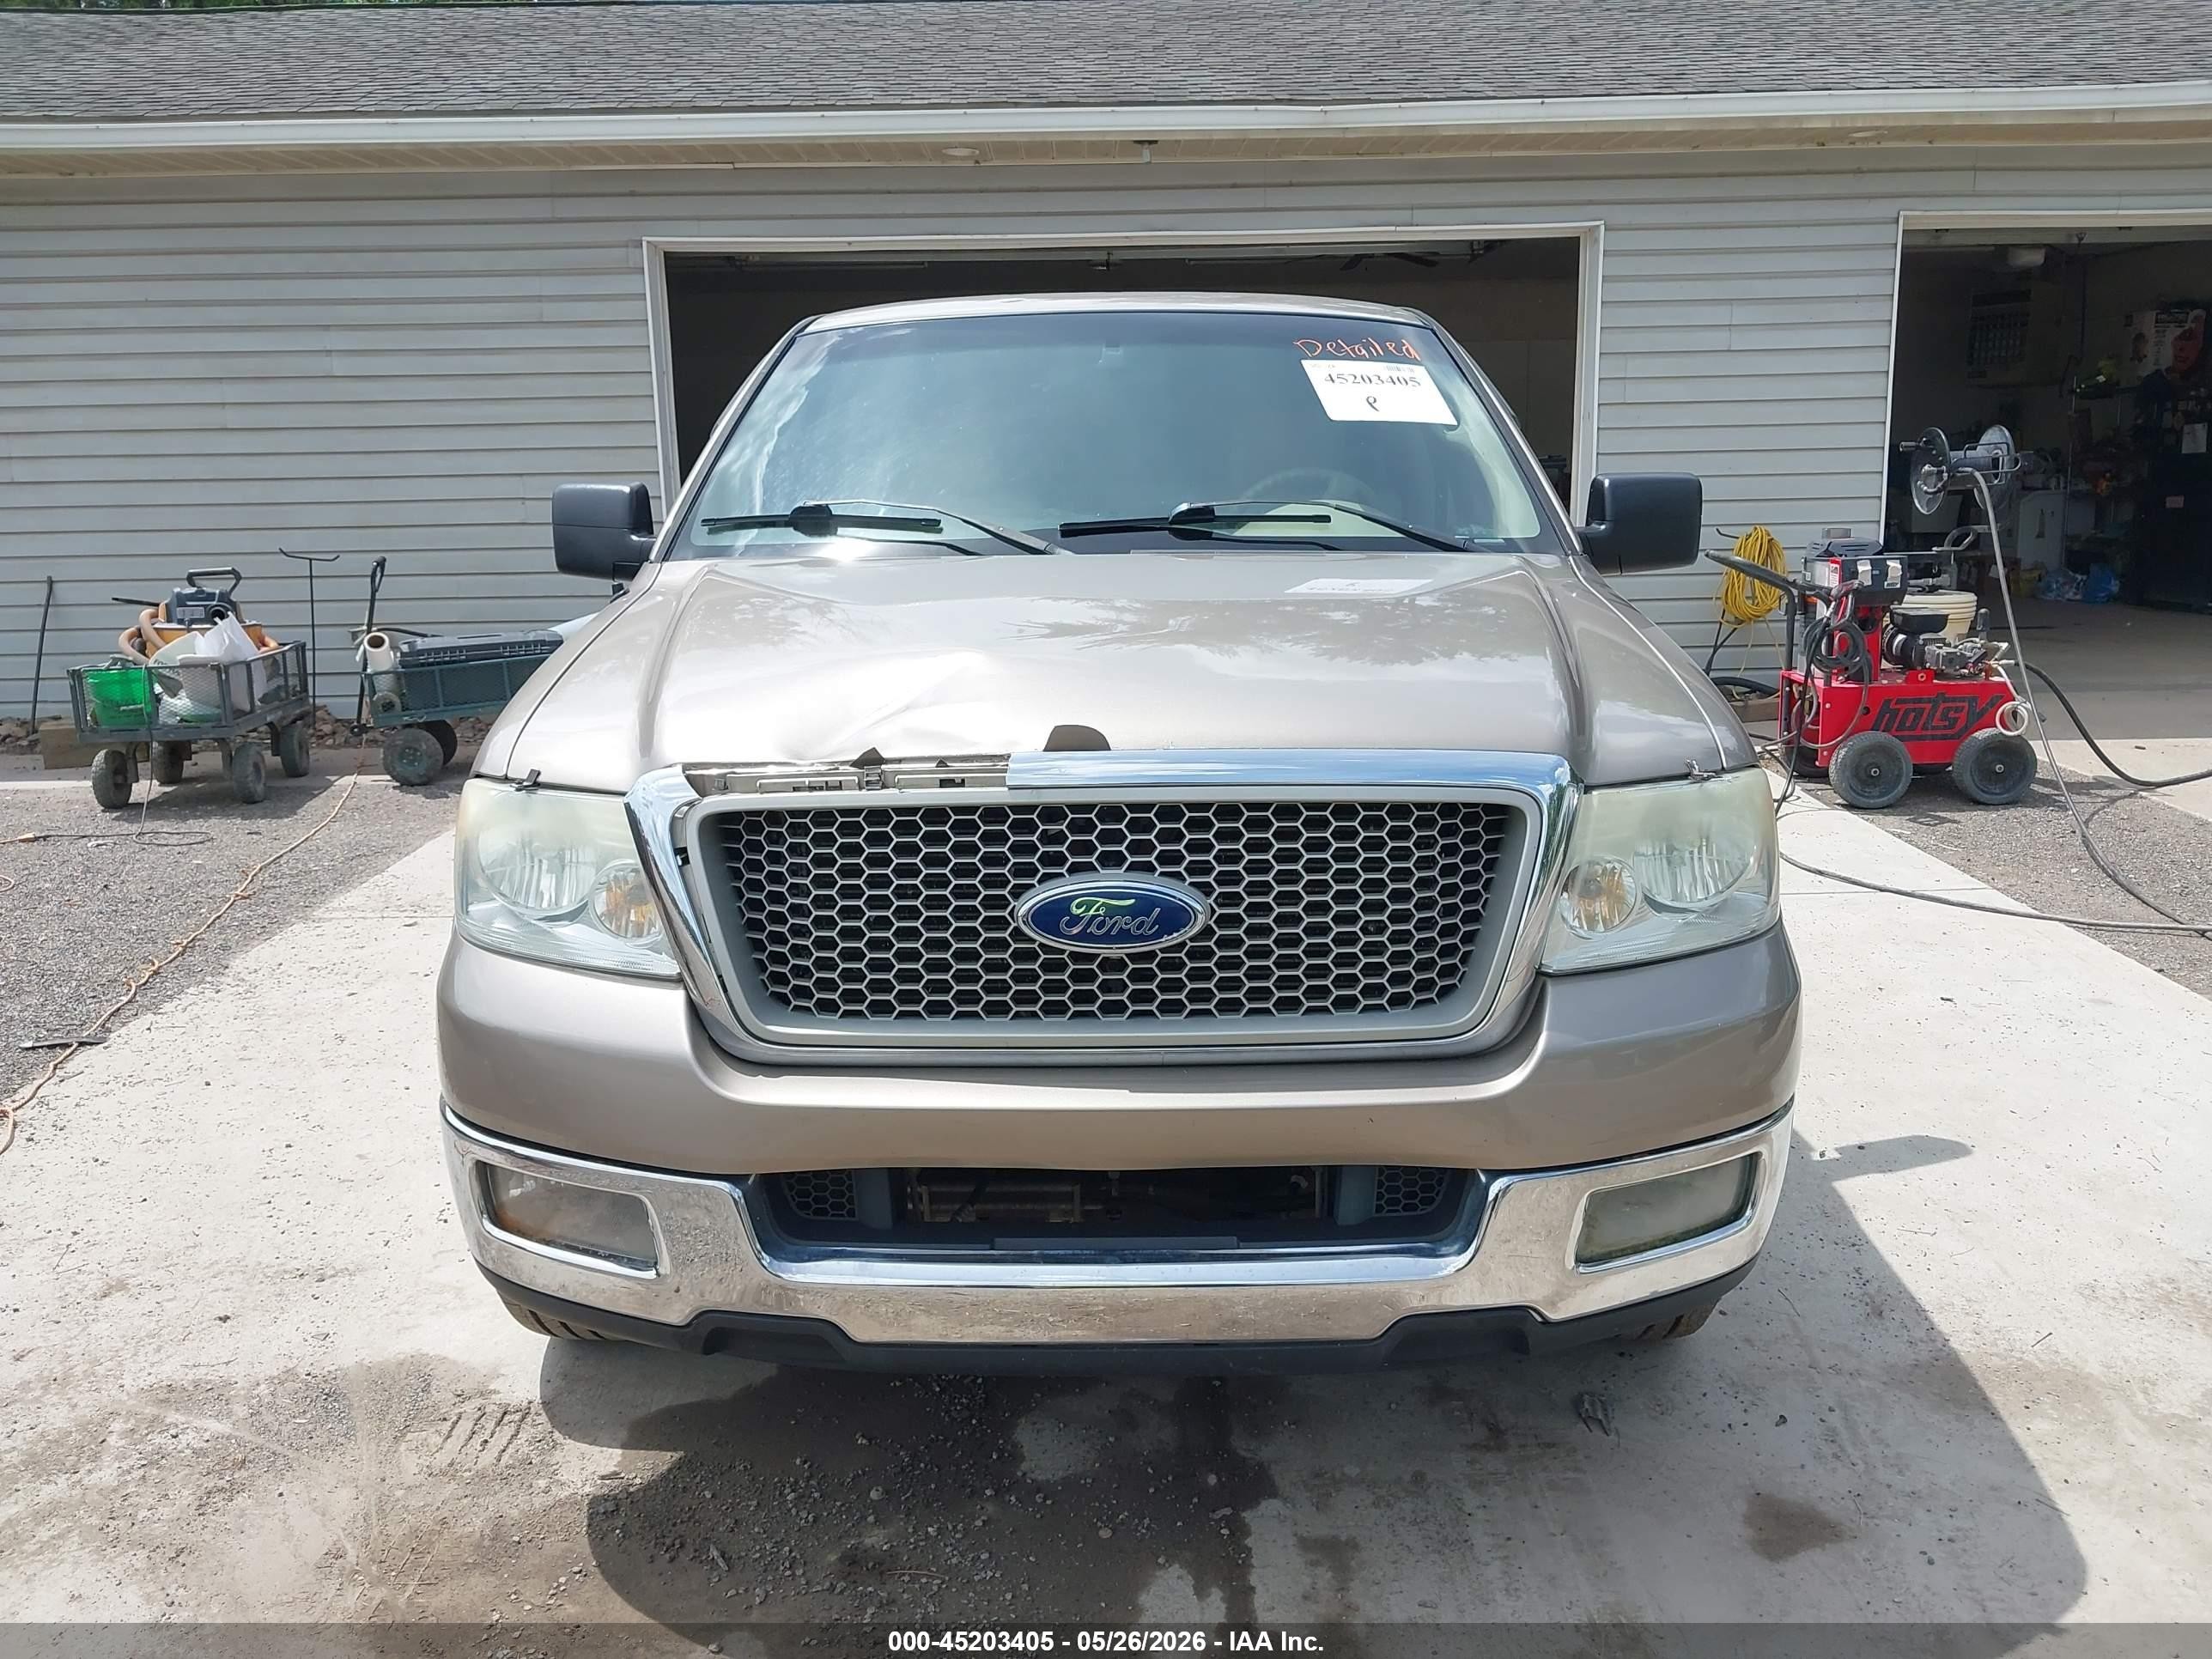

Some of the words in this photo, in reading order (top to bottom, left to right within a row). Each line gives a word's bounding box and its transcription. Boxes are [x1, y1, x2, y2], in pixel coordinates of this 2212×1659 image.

[1292, 337, 1421, 362] Detailed
[1324, 373, 1421, 386] 45203405
[1059, 896, 1161, 936] Ford
